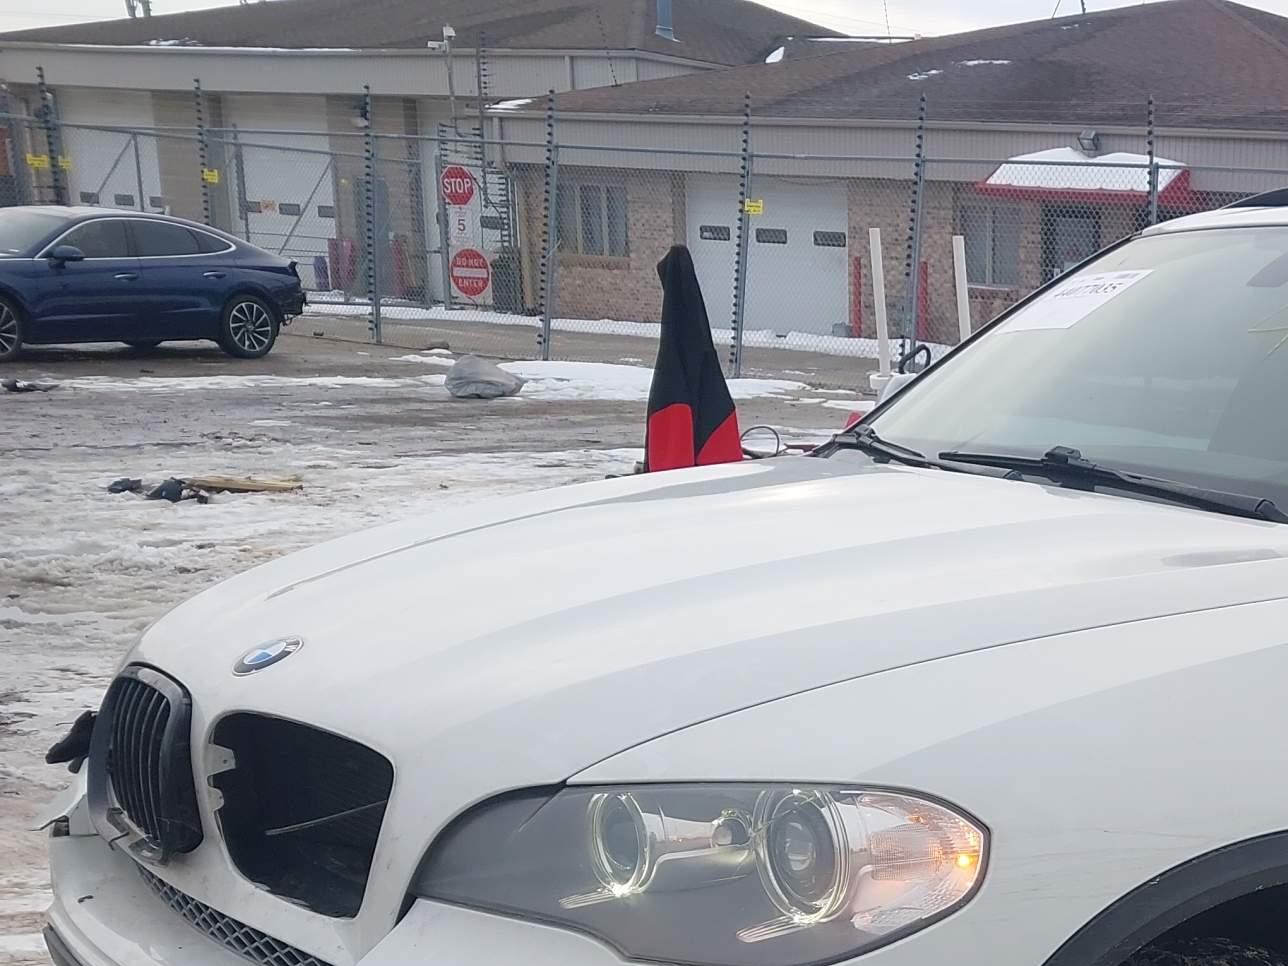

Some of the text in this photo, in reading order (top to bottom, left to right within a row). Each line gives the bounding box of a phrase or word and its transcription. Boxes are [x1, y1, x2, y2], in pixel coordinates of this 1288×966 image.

[443, 178, 472, 193] STOP
[457, 219, 466, 232] 5
[456, 257, 484, 267] DO NOT
[456, 278, 485, 289] ENTER
